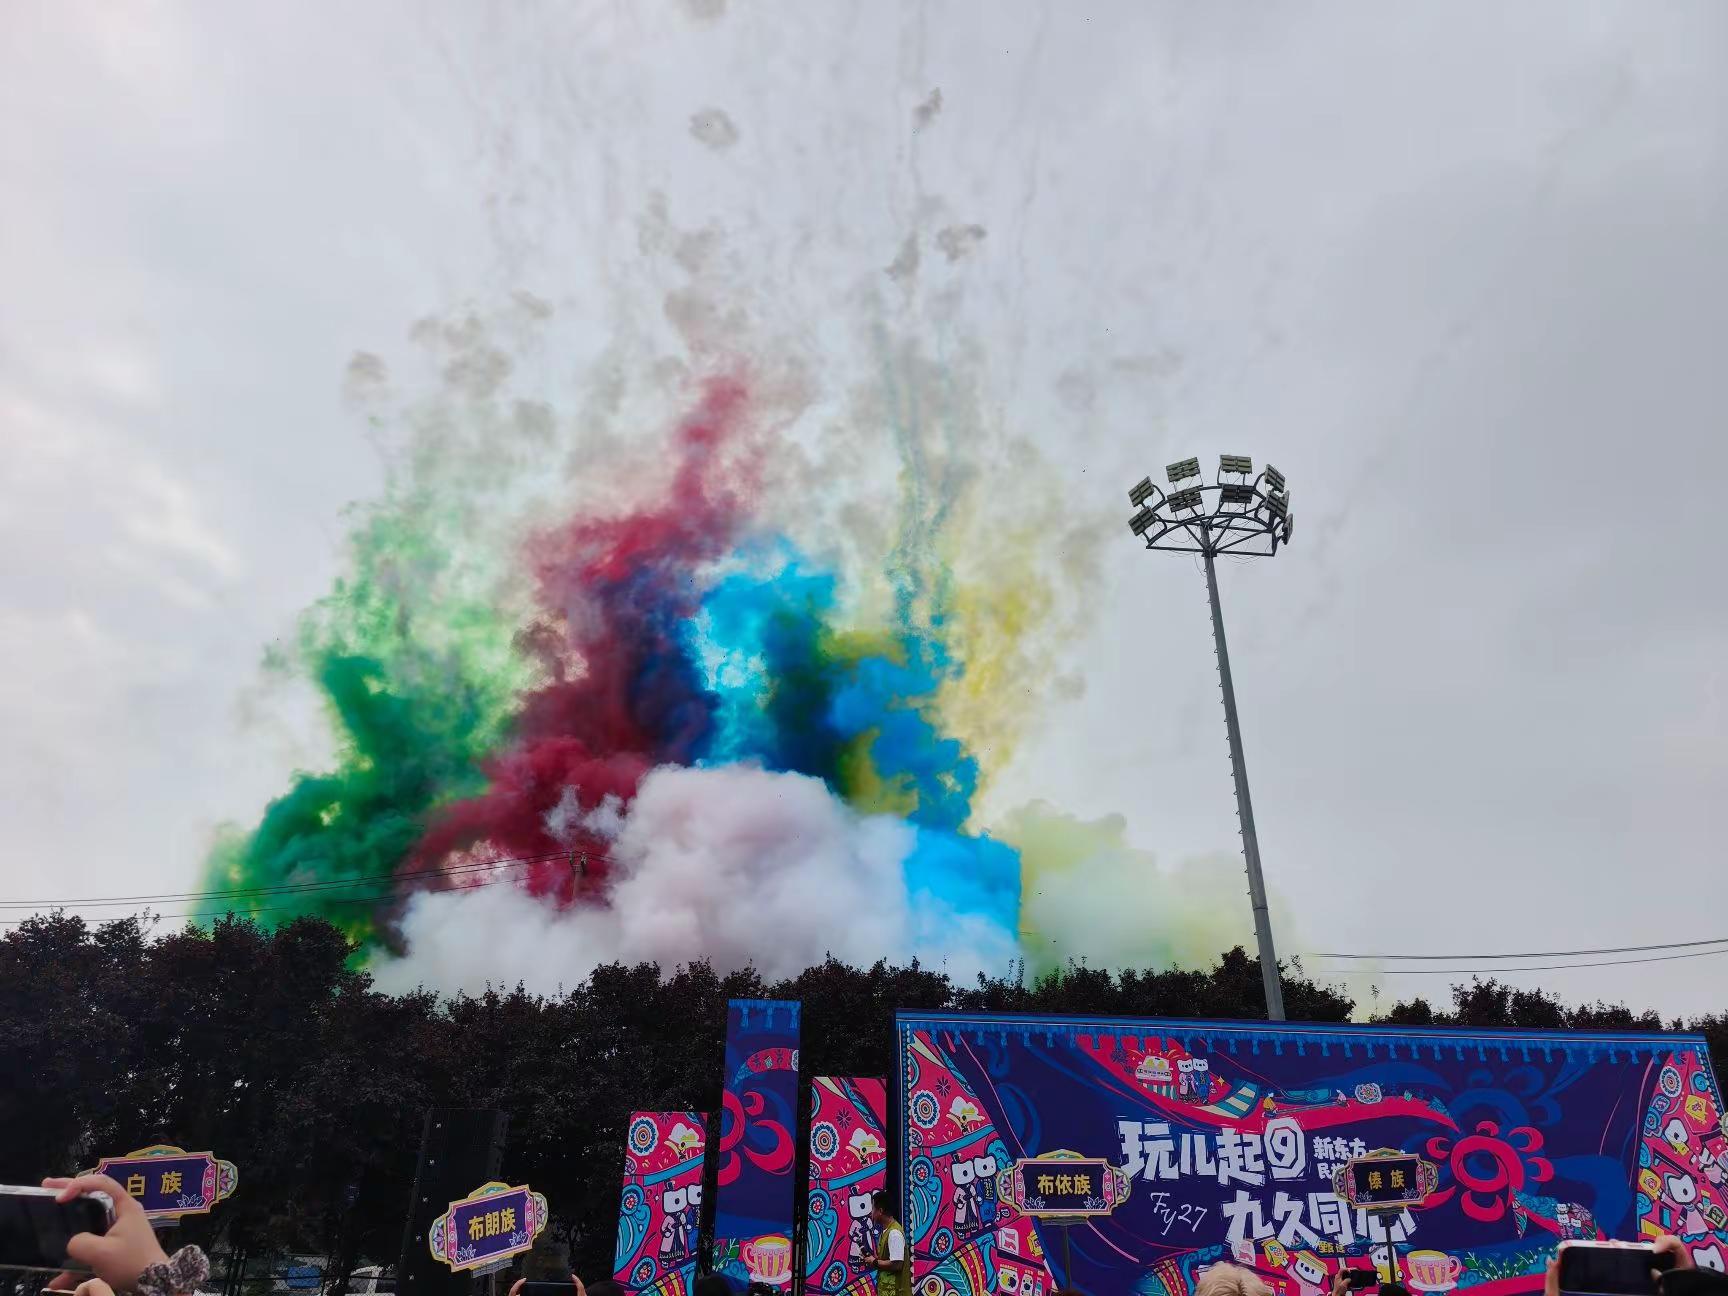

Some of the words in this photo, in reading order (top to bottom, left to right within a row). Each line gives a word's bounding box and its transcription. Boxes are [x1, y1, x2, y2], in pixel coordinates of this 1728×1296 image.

[127, 1171, 182, 1196] 白族
[1037, 1173, 1092, 1196] 布依族
[1367, 1169, 1405, 1190] 傣族
[468, 1207, 516, 1240] 布朗族
[1221, 1189, 1418, 1254] 九久同心
